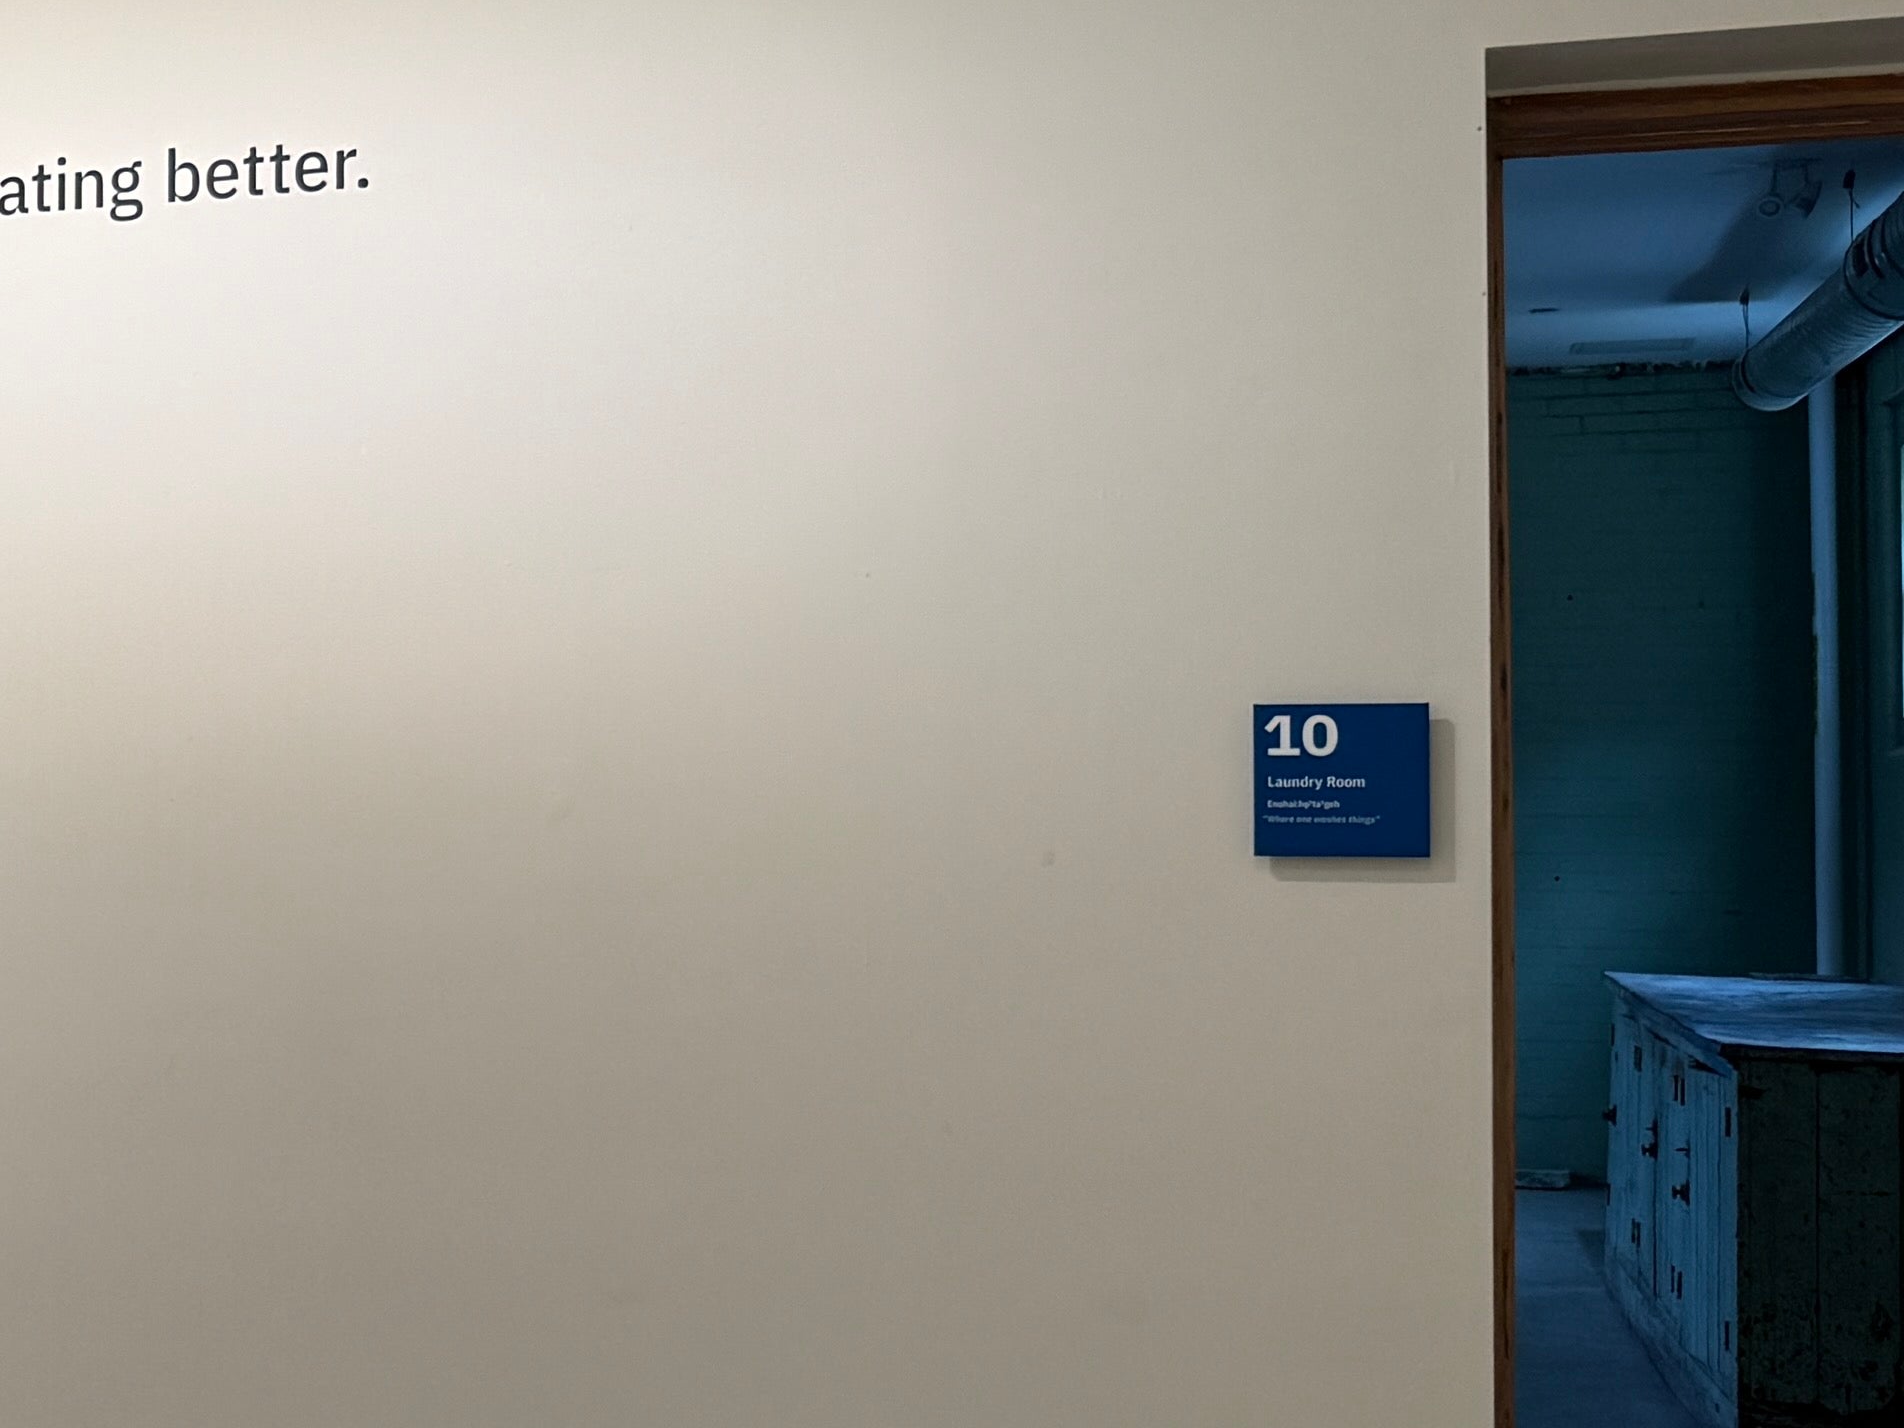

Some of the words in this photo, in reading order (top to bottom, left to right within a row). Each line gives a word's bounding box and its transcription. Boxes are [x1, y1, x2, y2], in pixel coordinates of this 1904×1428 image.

[168, 145, 368, 202] better.
[1265, 715, 1338, 756] 10
[1267, 775, 1323, 791] Laundry
[1326, 775, 1366, 788] Room
